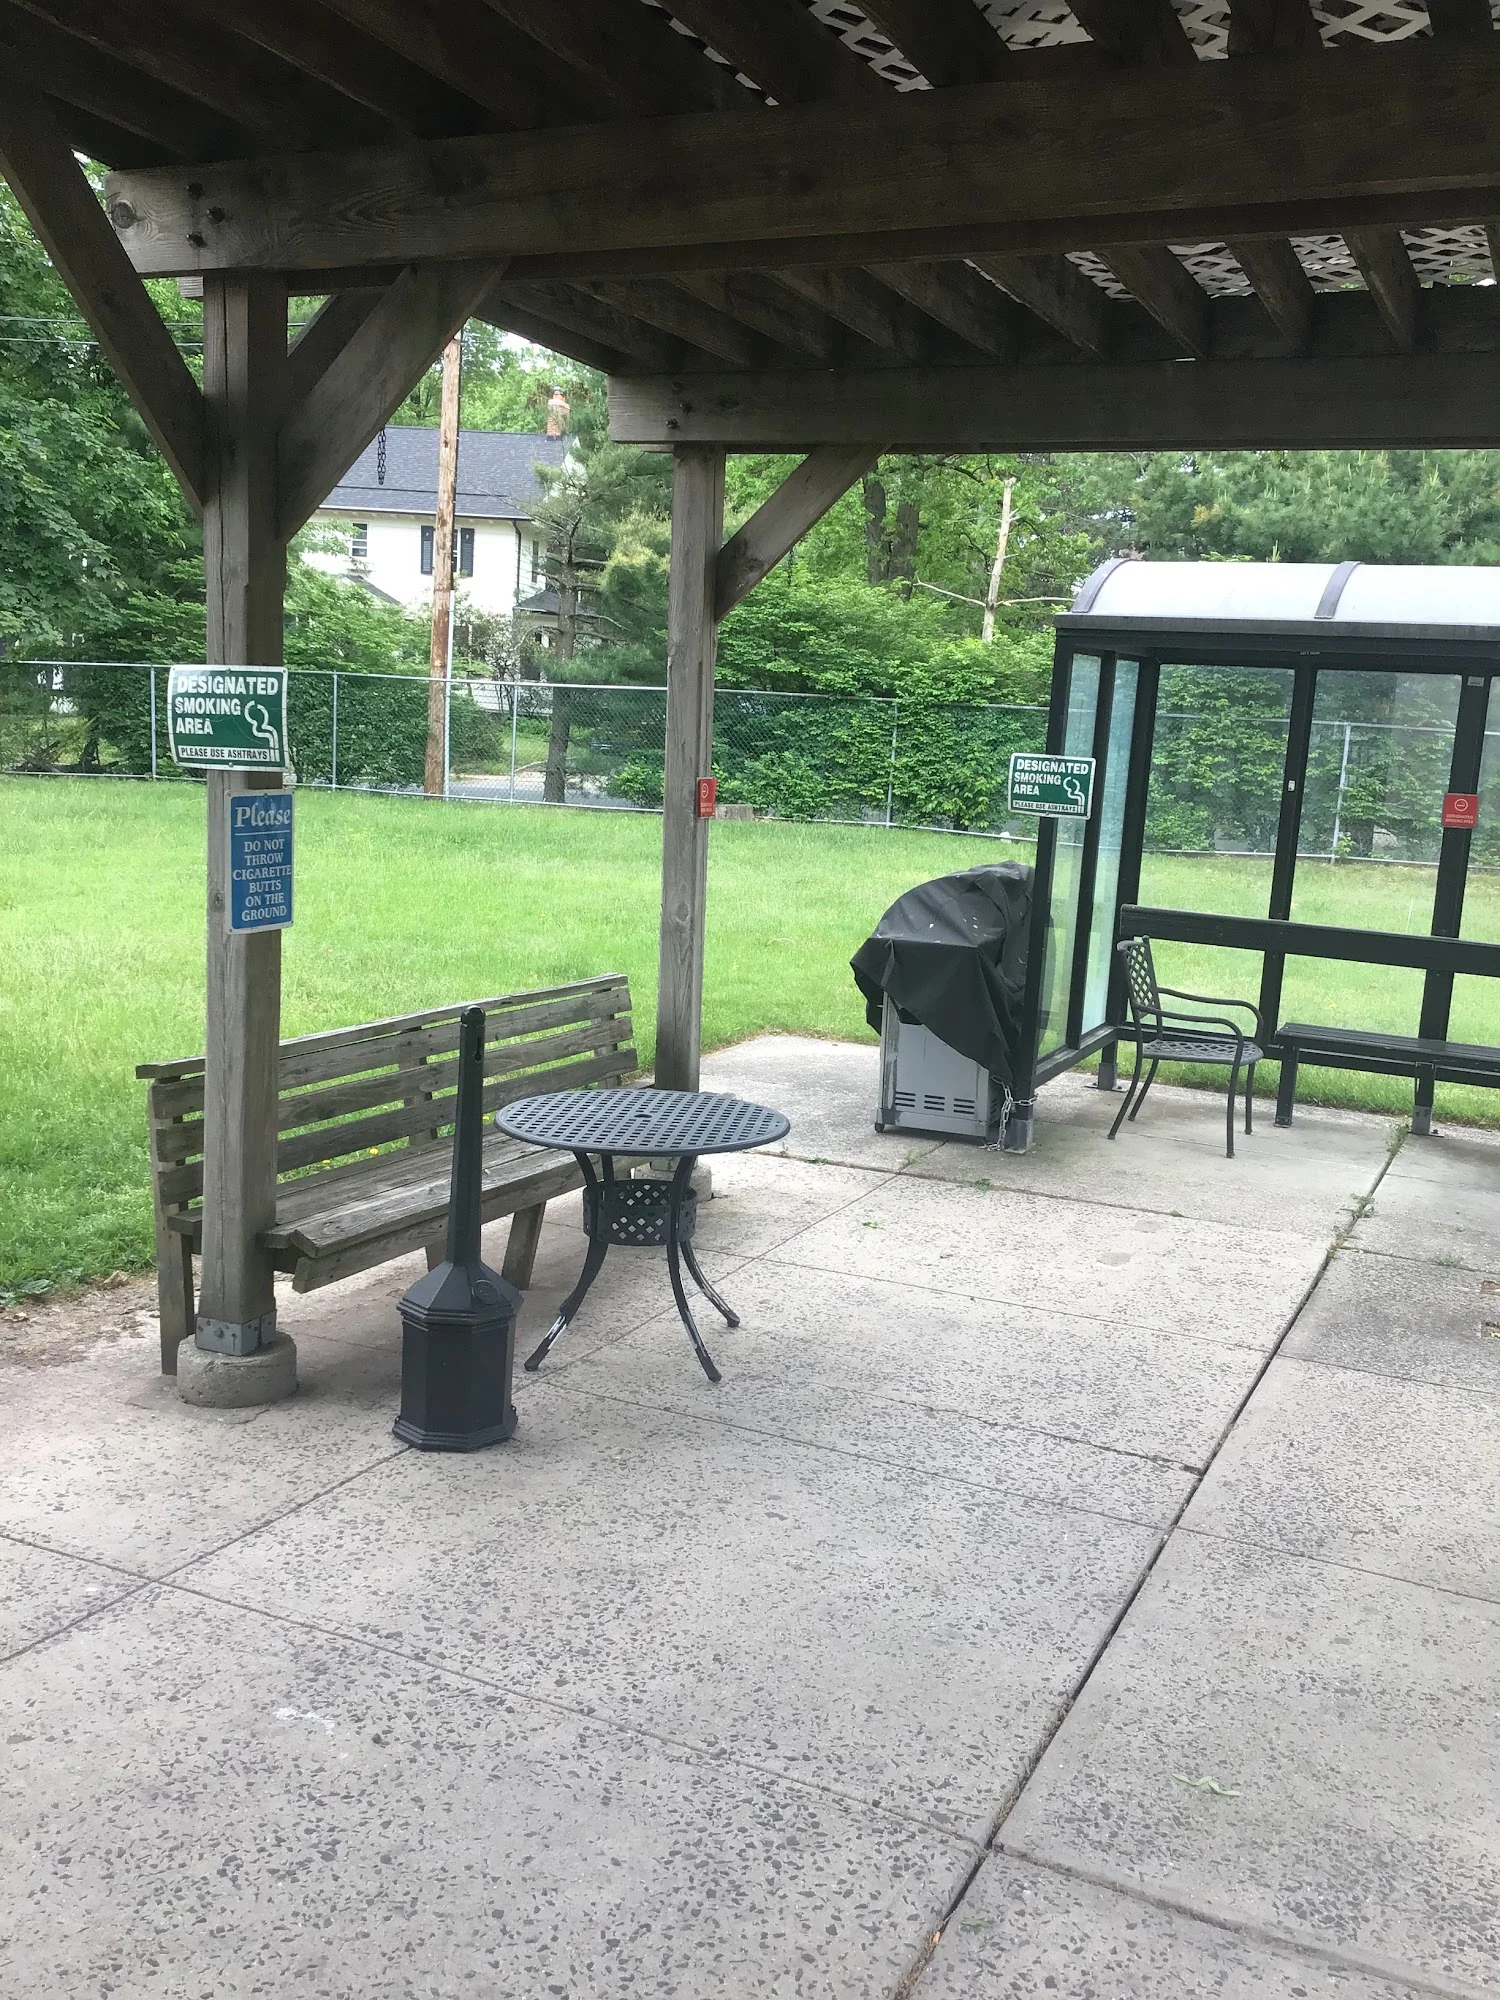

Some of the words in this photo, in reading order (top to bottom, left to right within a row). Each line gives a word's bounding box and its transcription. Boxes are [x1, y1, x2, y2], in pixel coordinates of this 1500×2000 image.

[177, 675, 279, 695] DESIGNATED
[174, 697, 241, 715] SMOKING
[175, 717, 214, 735] AREA
[181, 747, 208, 757] PLEASE
[210, 748, 225, 758] USE
[227, 749, 268, 760] ASHTRAYS
[1016, 759, 1089, 774] DESIGNATED
[1013, 772, 1061, 785] SMOKING
[1013, 784, 1040, 795] AREA
[1014, 801, 1034, 809] PLEASE
[233, 802, 291, 828] Please
[244, 840, 261, 853] DO
[263, 839, 285, 851] NOT
[244, 852, 284, 866] THROW
[232, 864, 292, 881] CIGARETTE
[248, 879, 282, 894] BUTTS
[245, 896, 262, 908] ON
[264, 892, 285, 905] THE
[241, 905, 287, 921] GROUND
